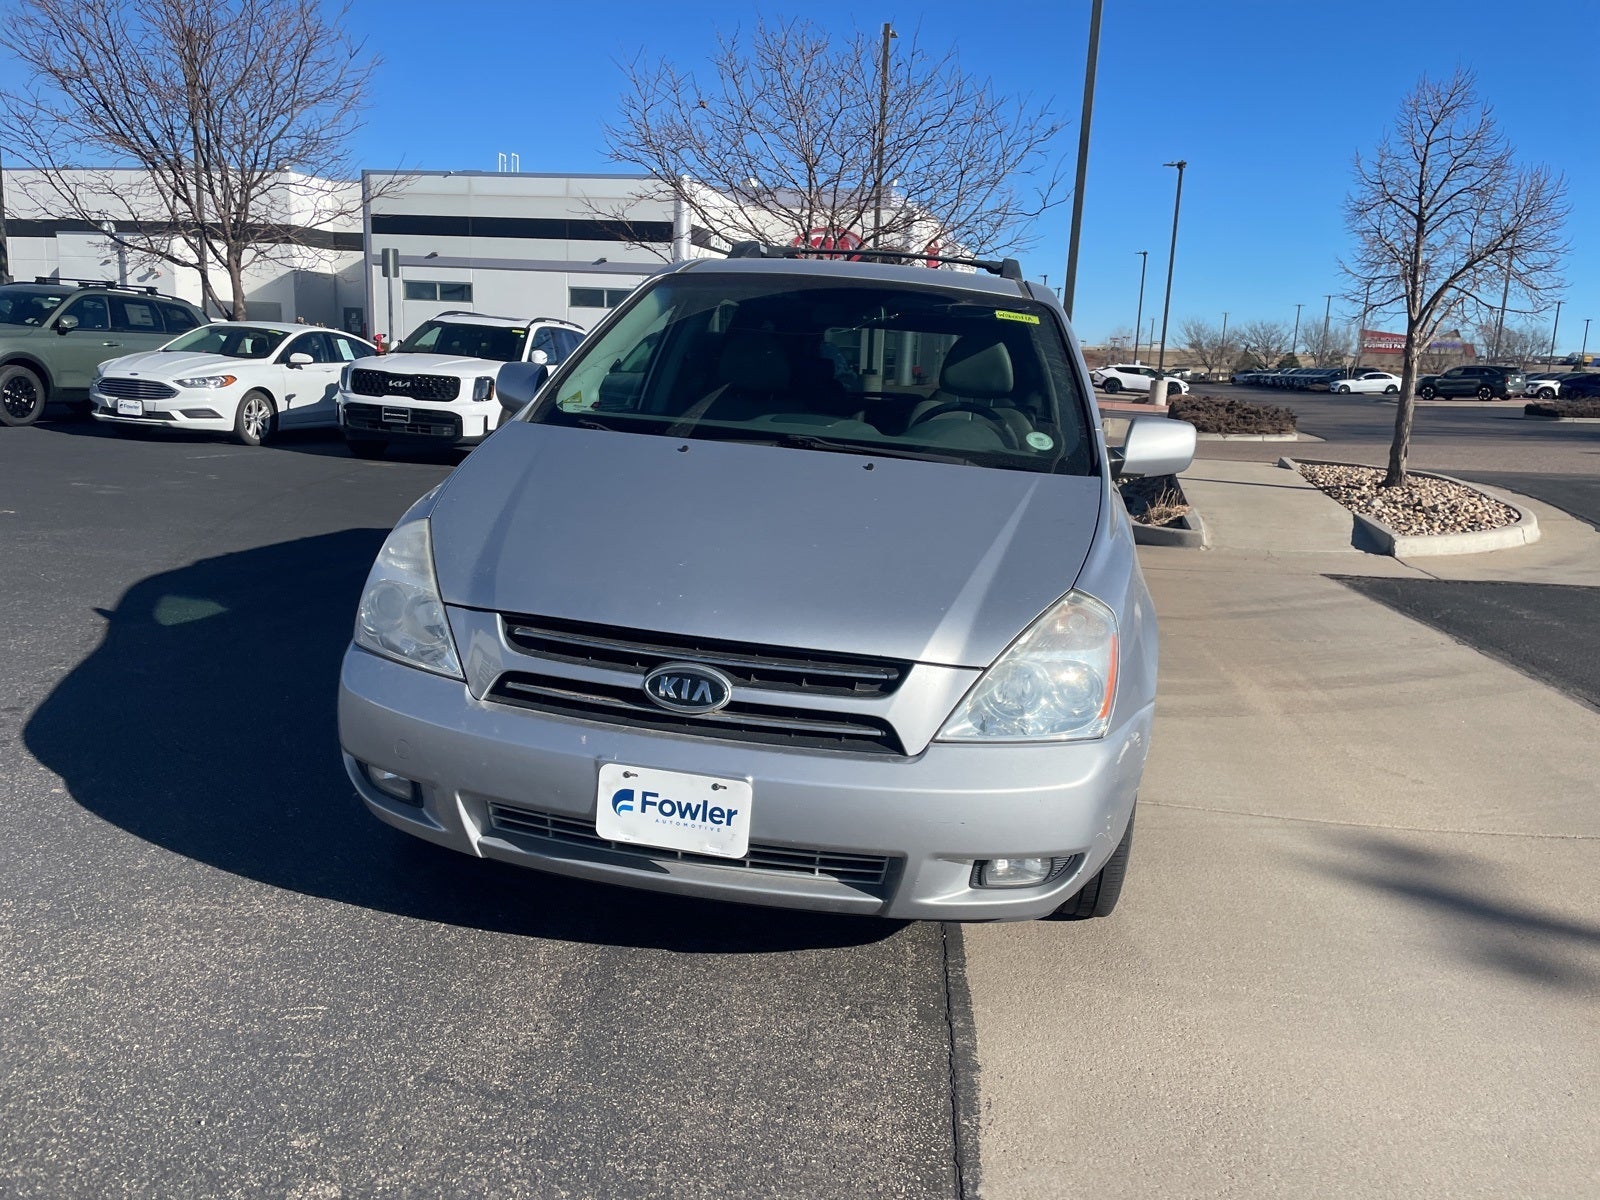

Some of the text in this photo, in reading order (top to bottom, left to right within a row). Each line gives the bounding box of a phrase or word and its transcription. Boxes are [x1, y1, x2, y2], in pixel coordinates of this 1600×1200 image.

[659, 675, 713, 703] KIA
[640, 790, 738, 827] Fowler
[655, 818, 721, 833] AUTOMOTIVE
